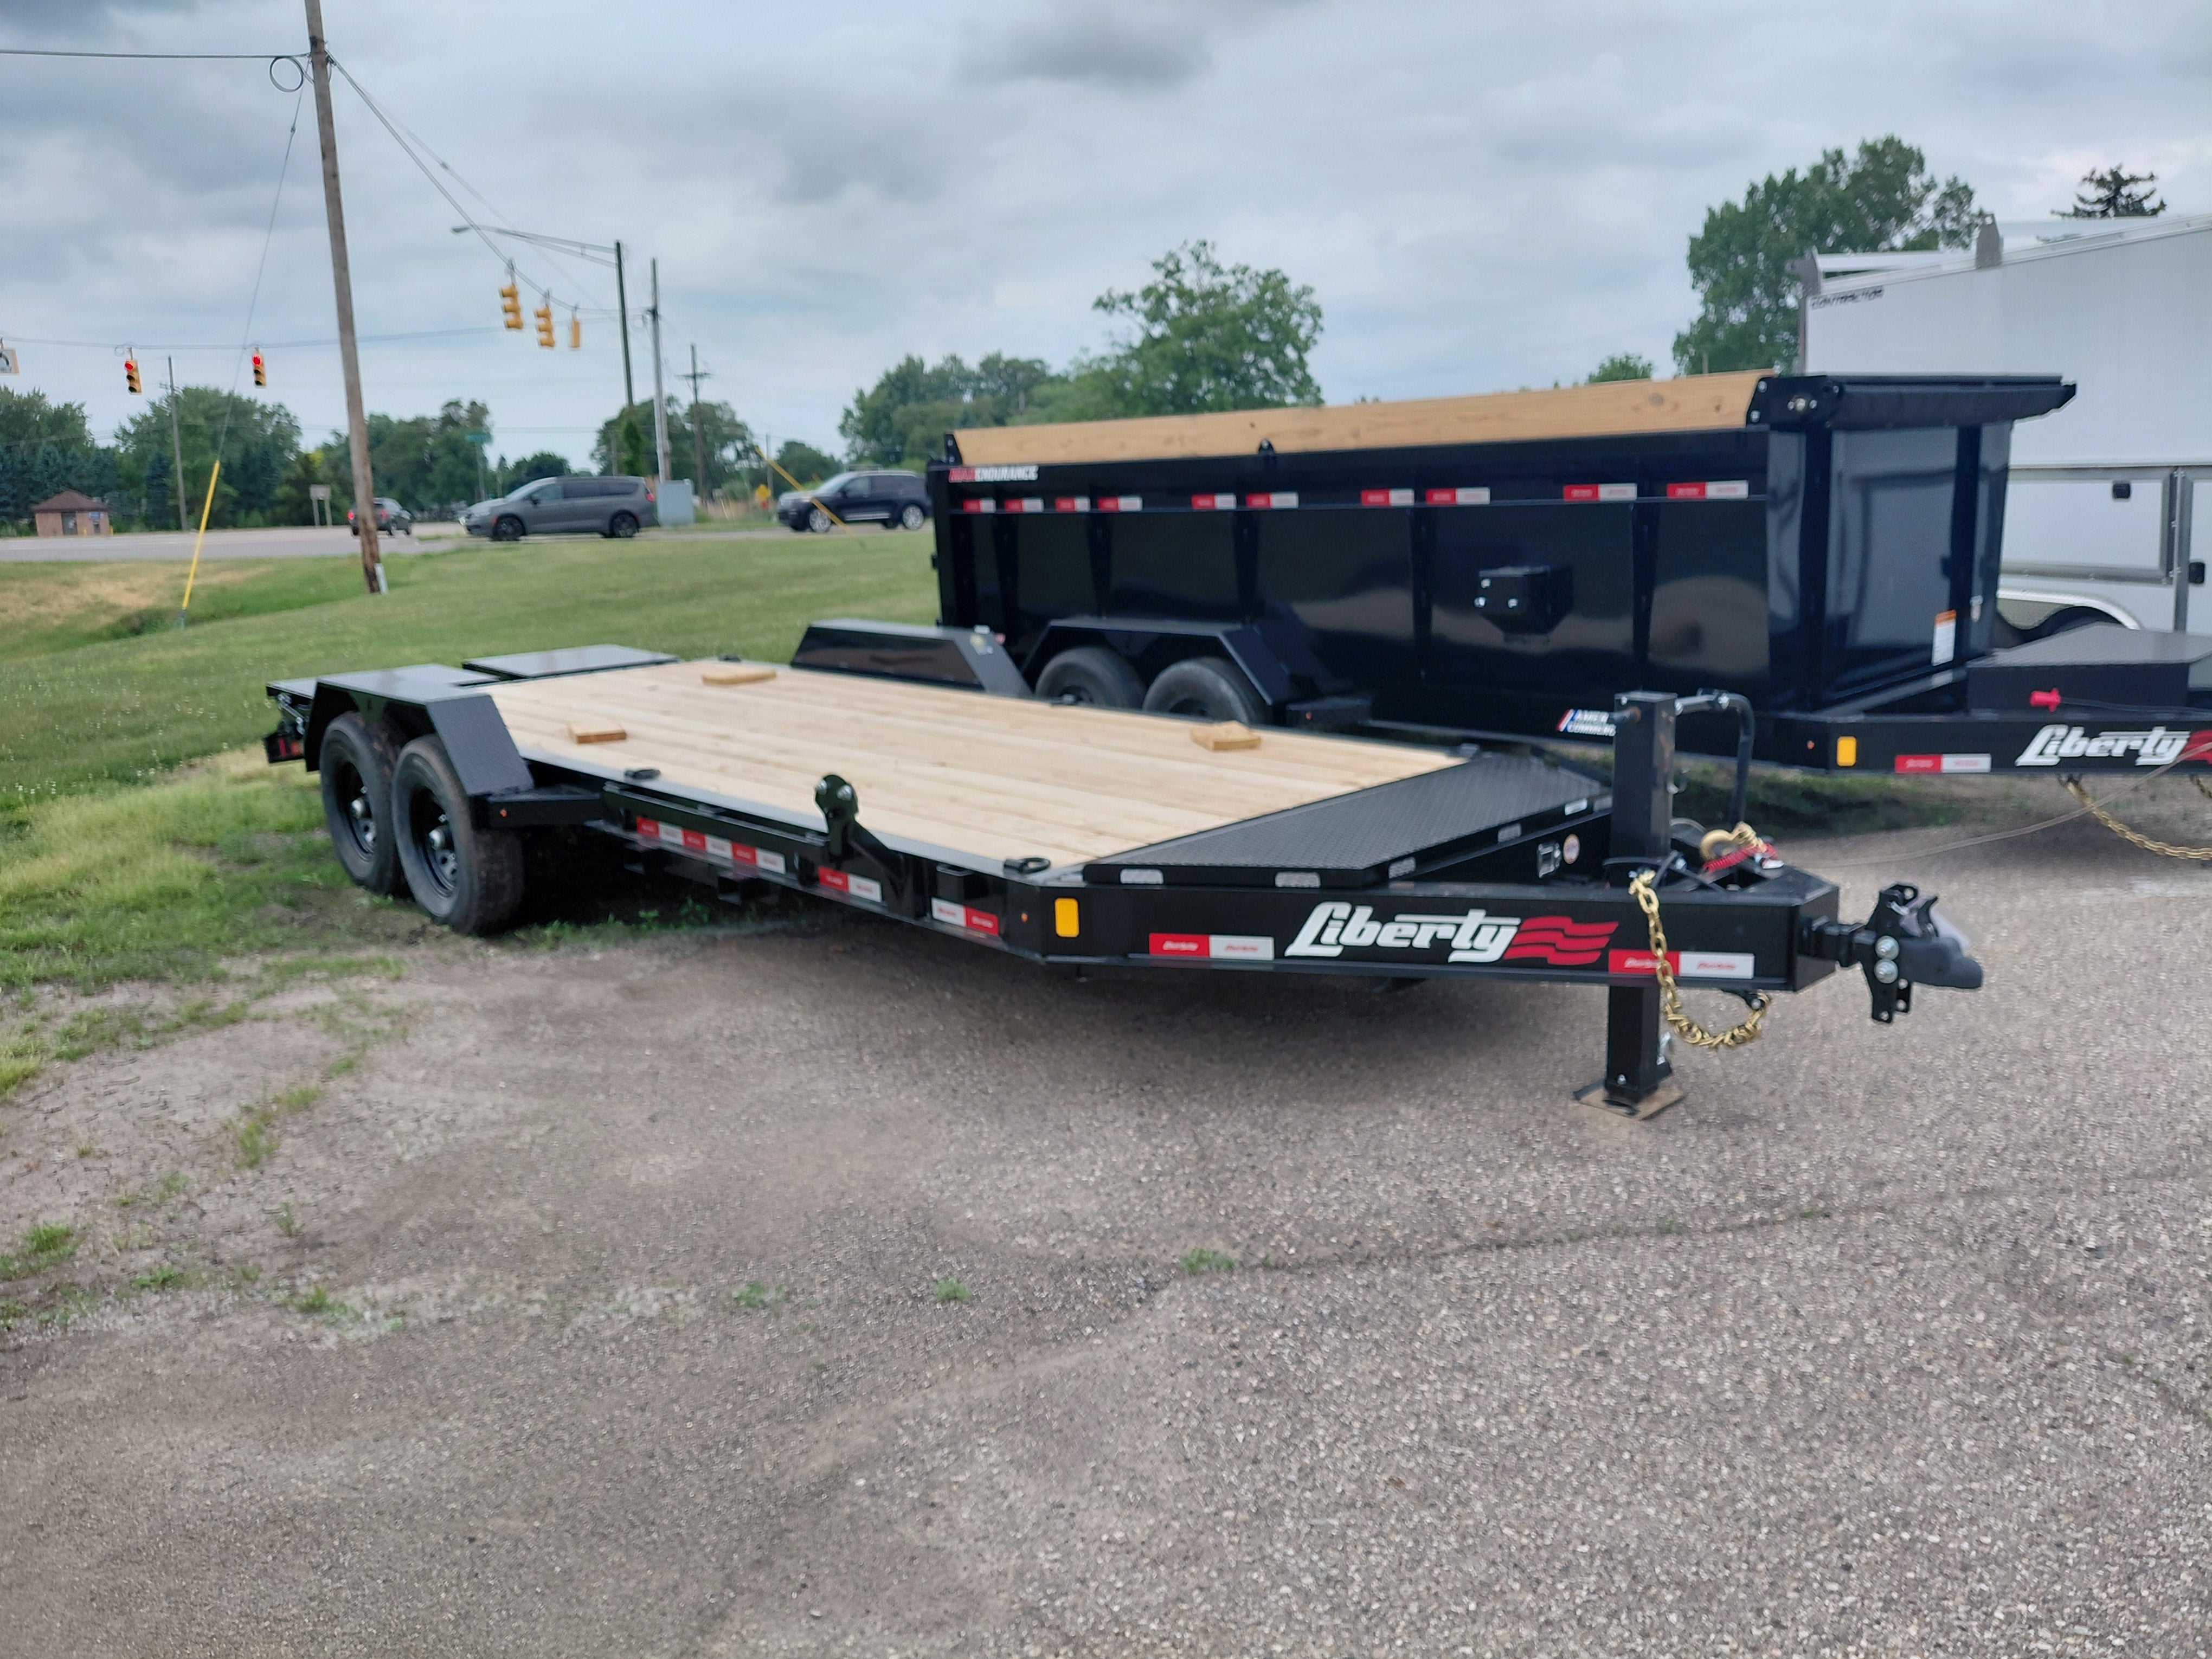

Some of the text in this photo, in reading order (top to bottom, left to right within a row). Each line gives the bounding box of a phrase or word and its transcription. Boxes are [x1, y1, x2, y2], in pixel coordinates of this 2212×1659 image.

[1567, 722, 1616, 736] COMMERC
[1573, 709, 1610, 723] AMER
[2014, 724, 2191, 767] Liberty
[1284, 901, 1521, 963] Liberty
